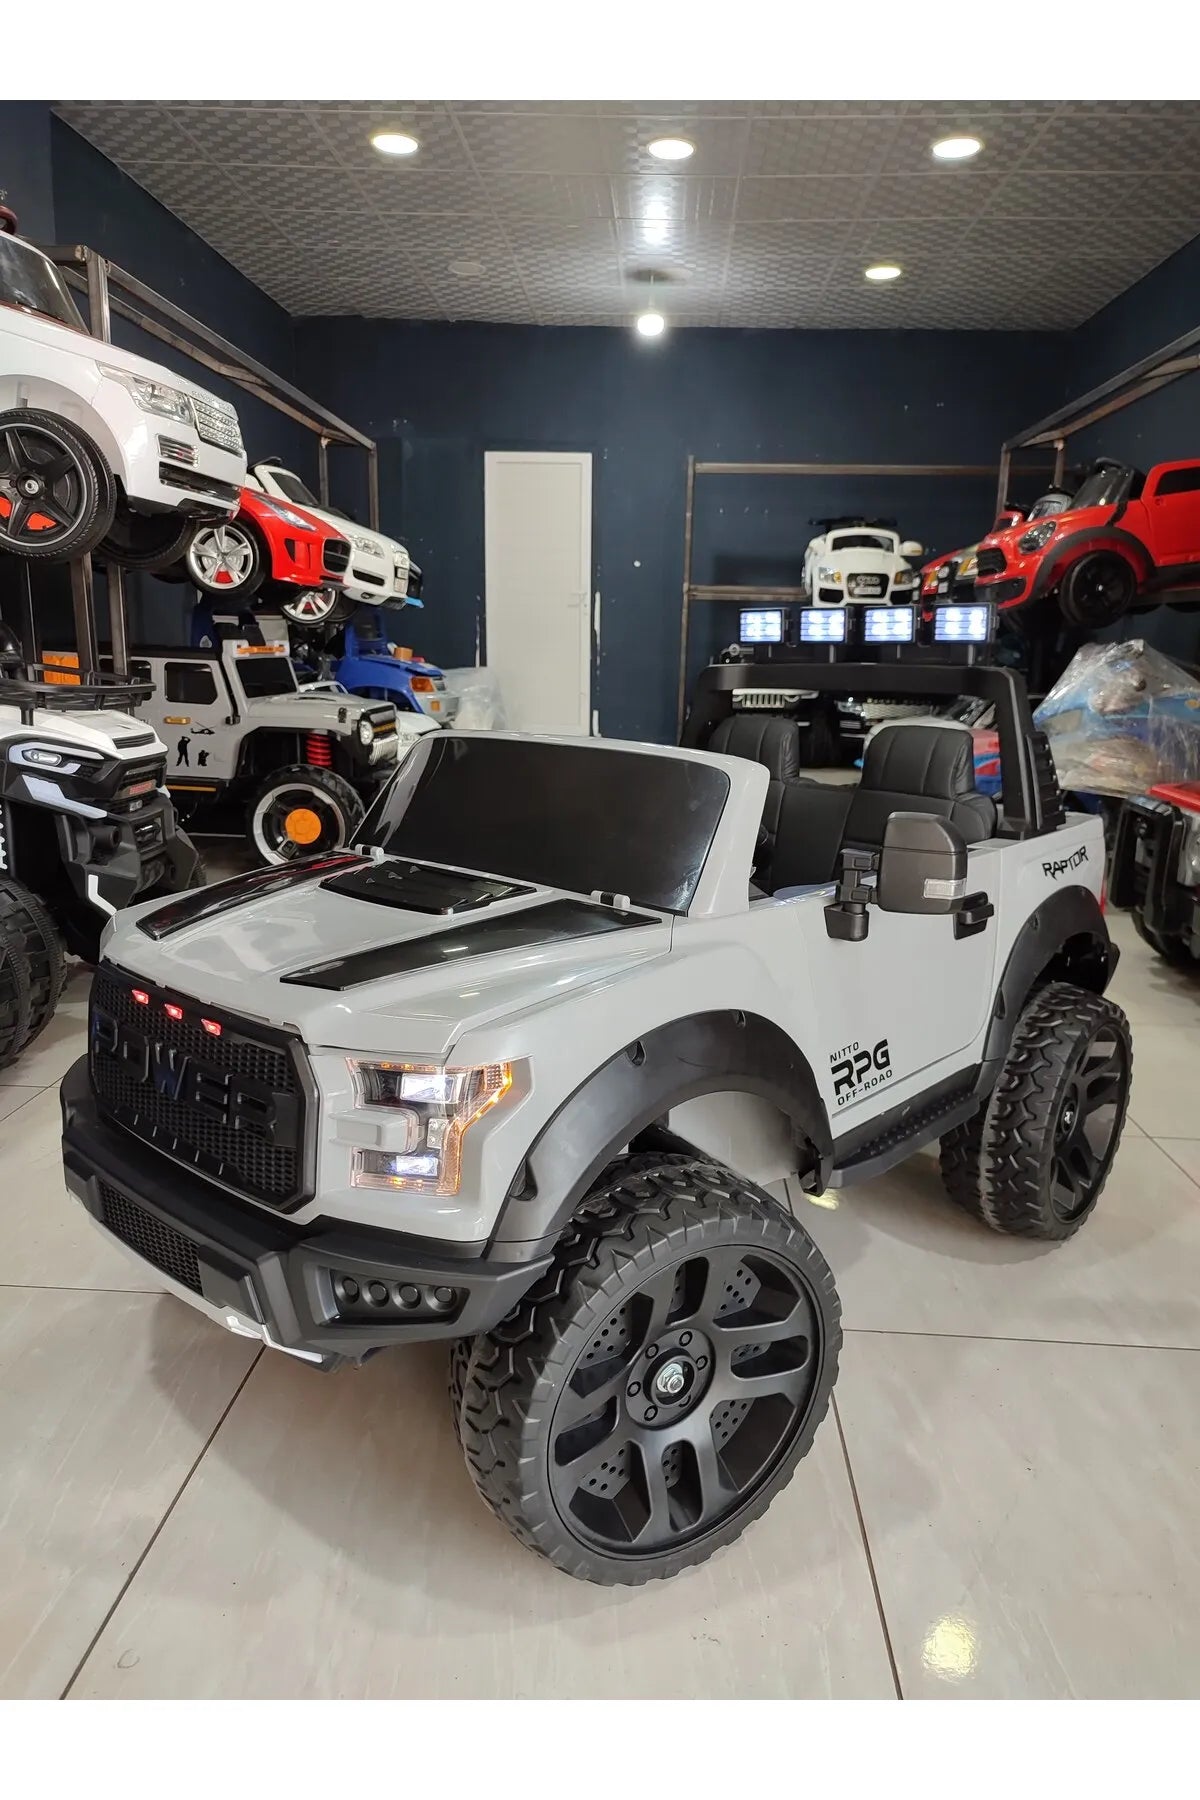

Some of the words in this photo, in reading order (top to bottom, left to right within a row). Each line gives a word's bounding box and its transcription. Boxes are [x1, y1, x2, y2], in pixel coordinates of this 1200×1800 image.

[1042, 845, 1089, 880] RAPTOR
[829, 1041, 859, 1063] NITTO
[831, 1038, 890, 1096] RPG
[91, 1009, 278, 1142] POWER
[837, 1069, 893, 1106] OFF-ROAD
